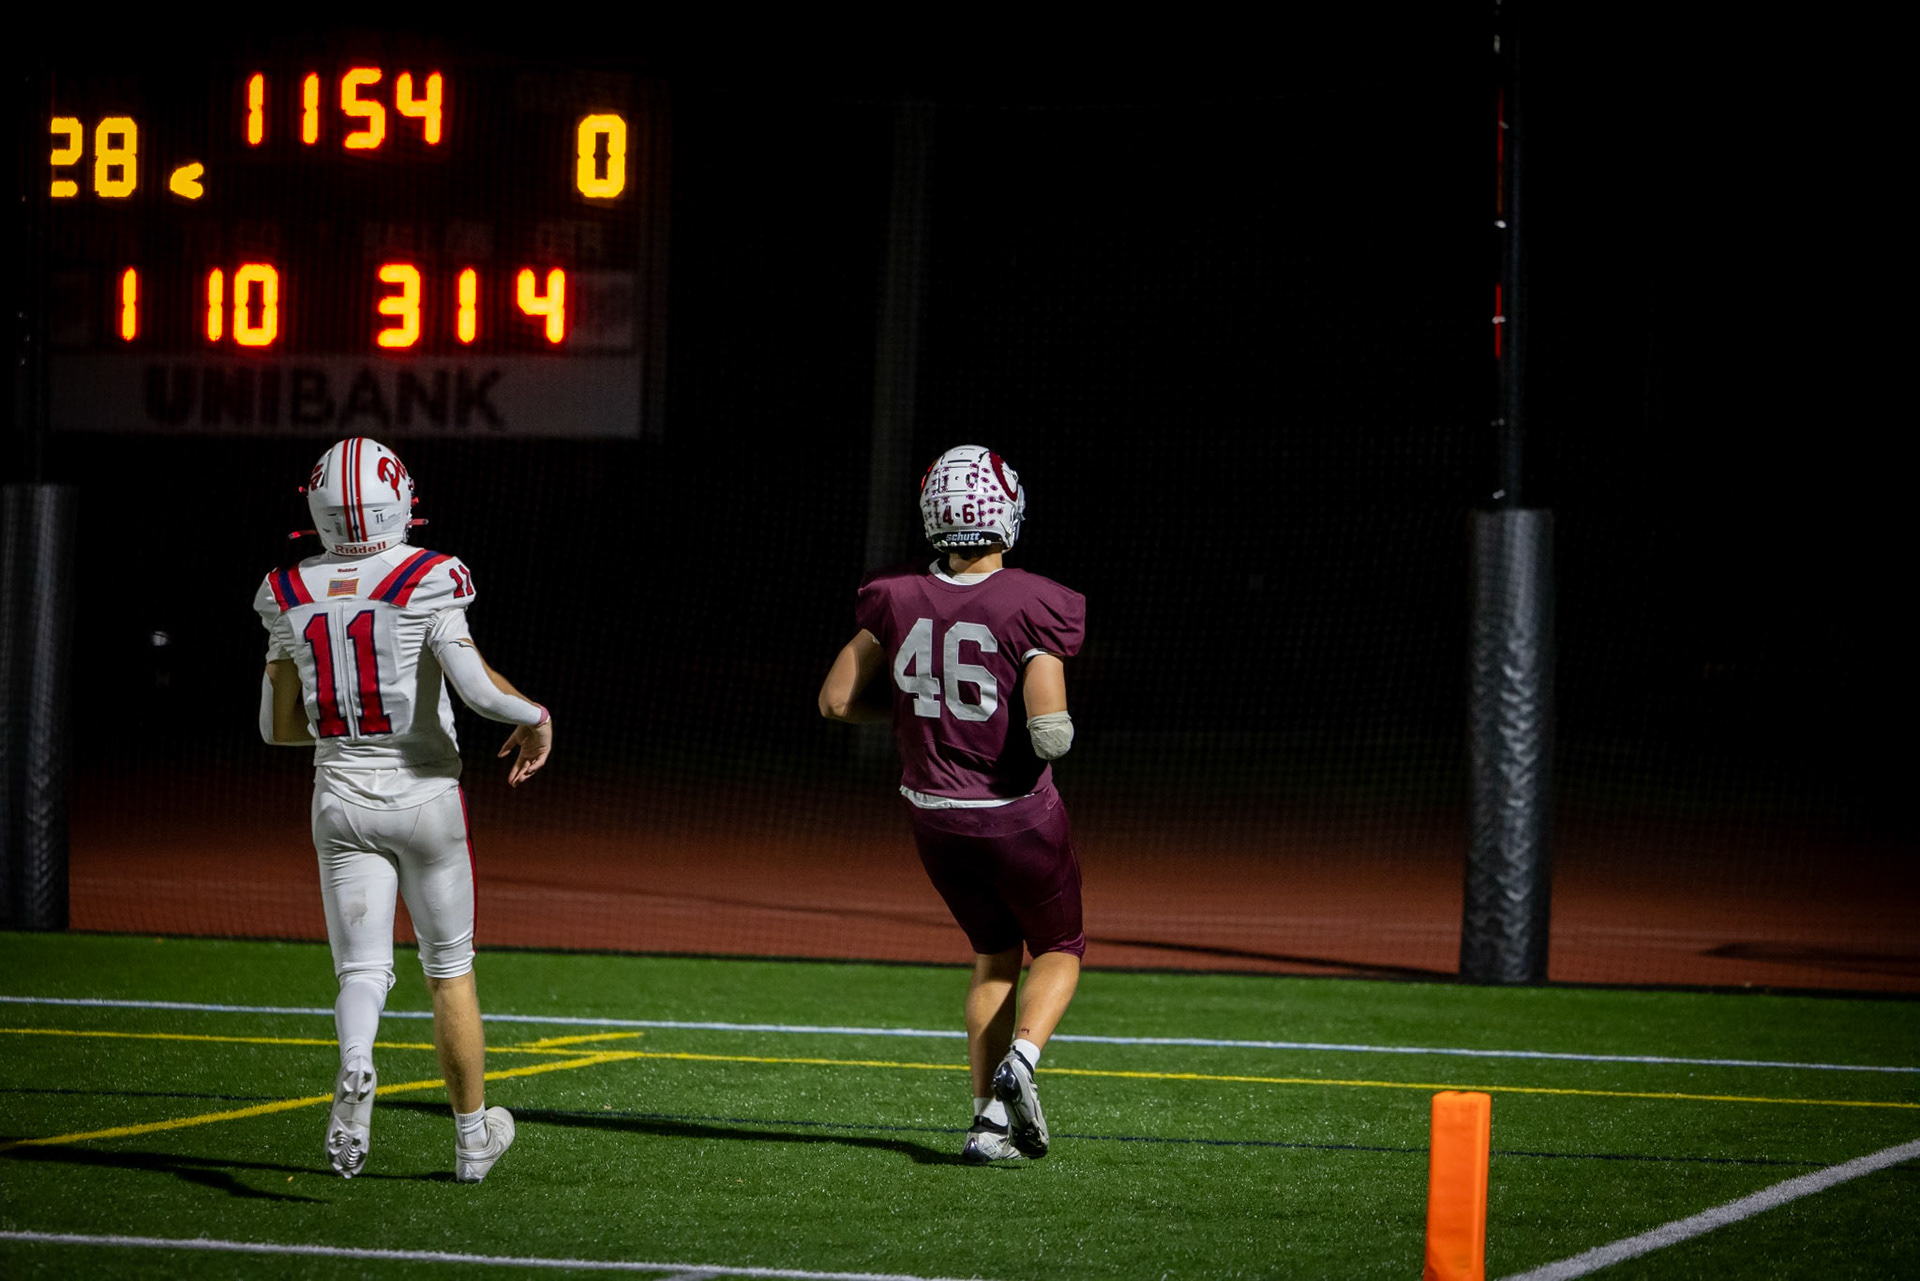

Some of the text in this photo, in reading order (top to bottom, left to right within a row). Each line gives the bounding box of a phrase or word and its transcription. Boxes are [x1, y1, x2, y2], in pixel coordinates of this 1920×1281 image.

[576, 113, 628, 199] 0
[121, 267, 138, 341] 1
[206, 263, 280, 346] 10
[145, 366, 507, 427] UNIBANK
[334, 541, 387, 554] Riddell
[942, 503, 976, 525] 46
[945, 532, 981, 542] schutt
[449, 564, 474, 599] 11
[304, 609, 393, 738] 11
[893, 617, 998, 722] 46
